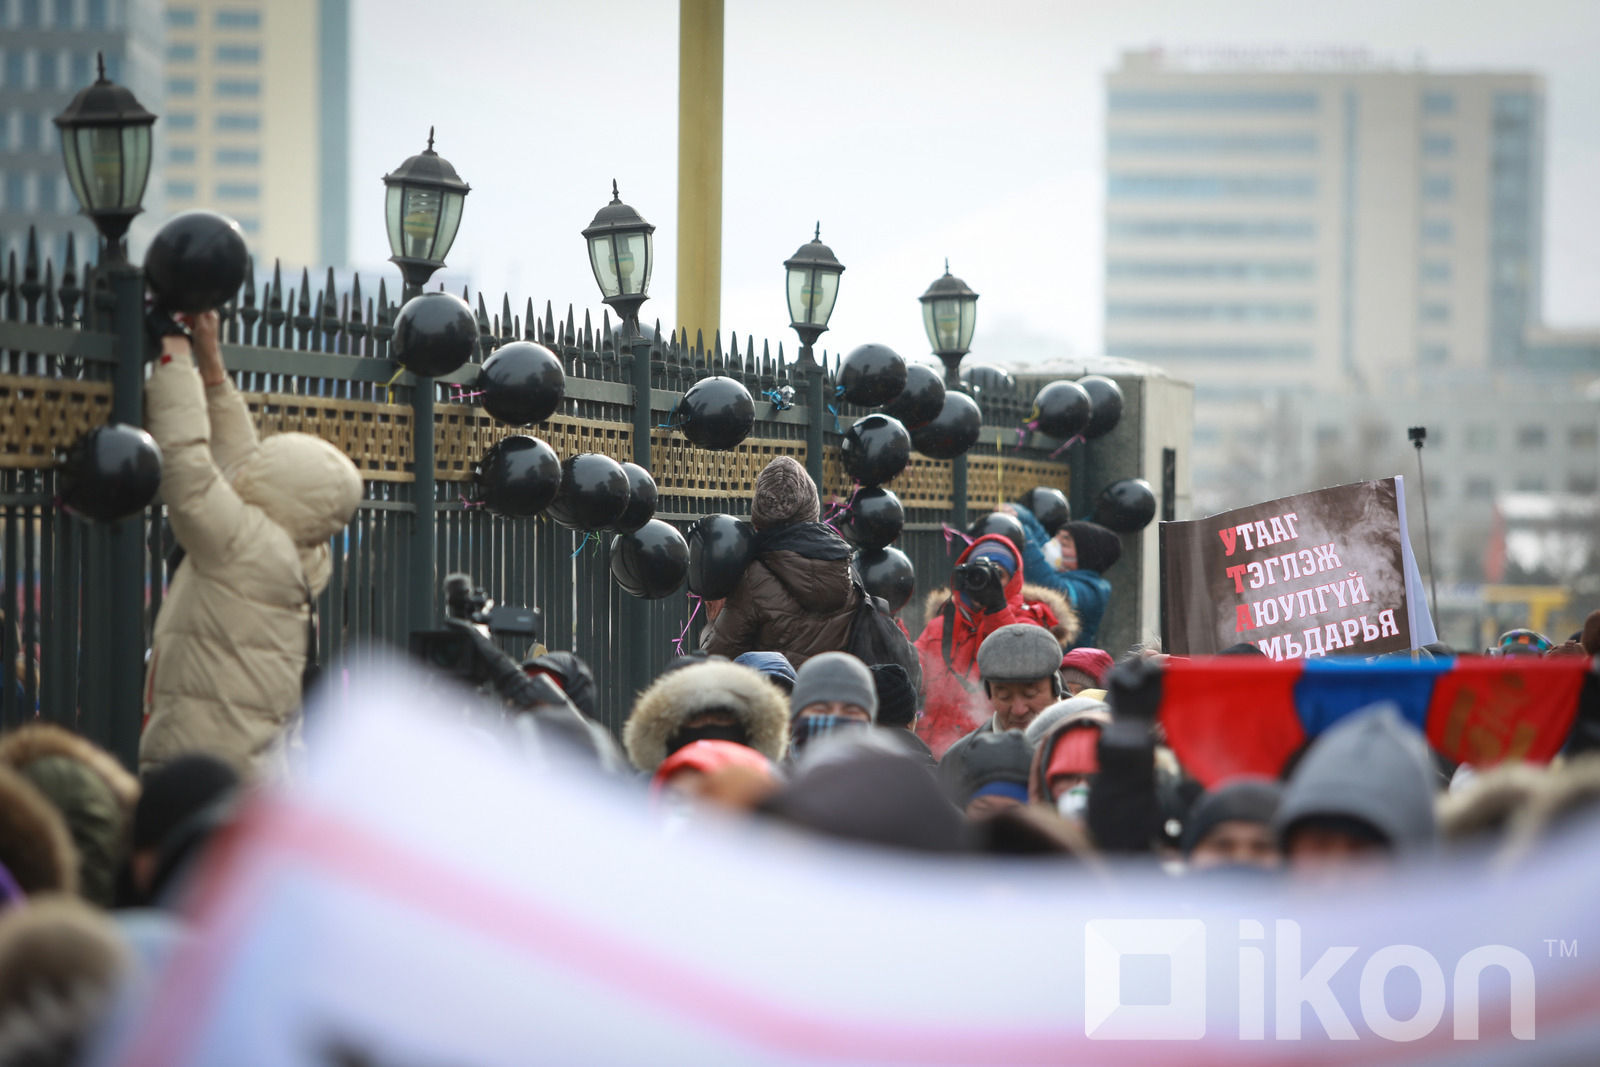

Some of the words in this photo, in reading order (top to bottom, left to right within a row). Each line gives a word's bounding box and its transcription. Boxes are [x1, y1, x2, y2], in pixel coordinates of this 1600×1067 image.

[1218, 512, 1299, 556] УТААГ
[1226, 542, 1342, 594] ТЭГЛЭЖ
[1234, 571, 1370, 633] АЮУЛГҮЙ
[1249, 608, 1400, 662] МЬДАРЬЯ
